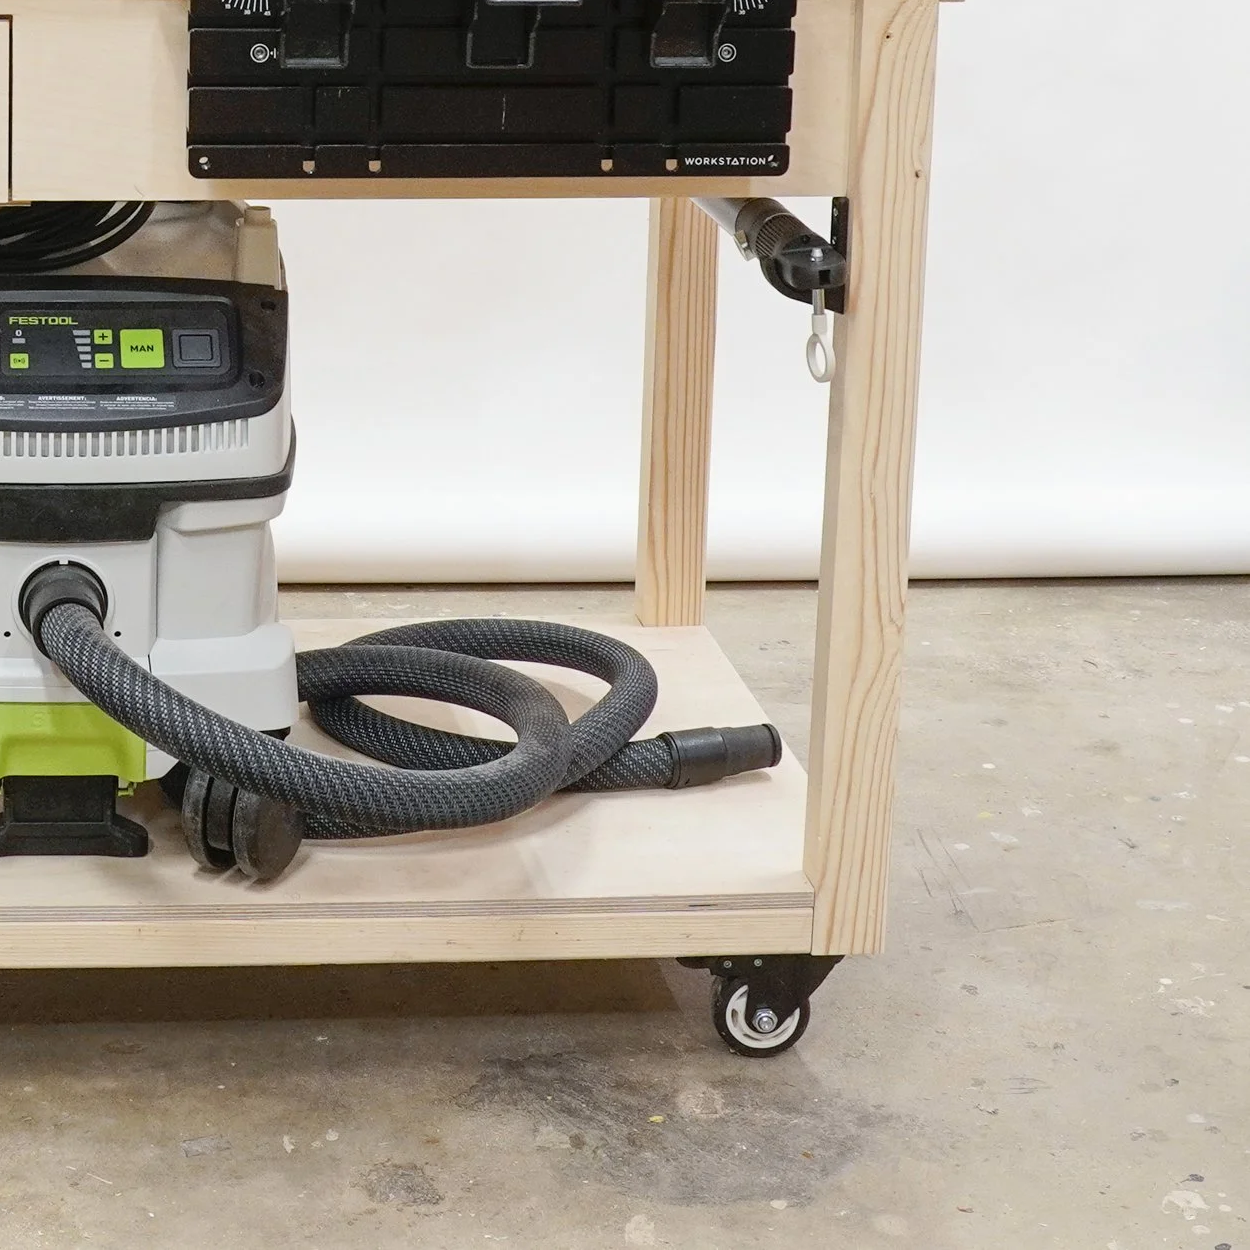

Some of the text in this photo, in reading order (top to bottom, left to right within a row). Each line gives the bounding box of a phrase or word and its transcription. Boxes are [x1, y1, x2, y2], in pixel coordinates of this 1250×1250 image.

[684, 156, 767, 166] WORKSTATION
[8, 316, 79, 325] FESTOOL
[129, 344, 155, 352] MAN
